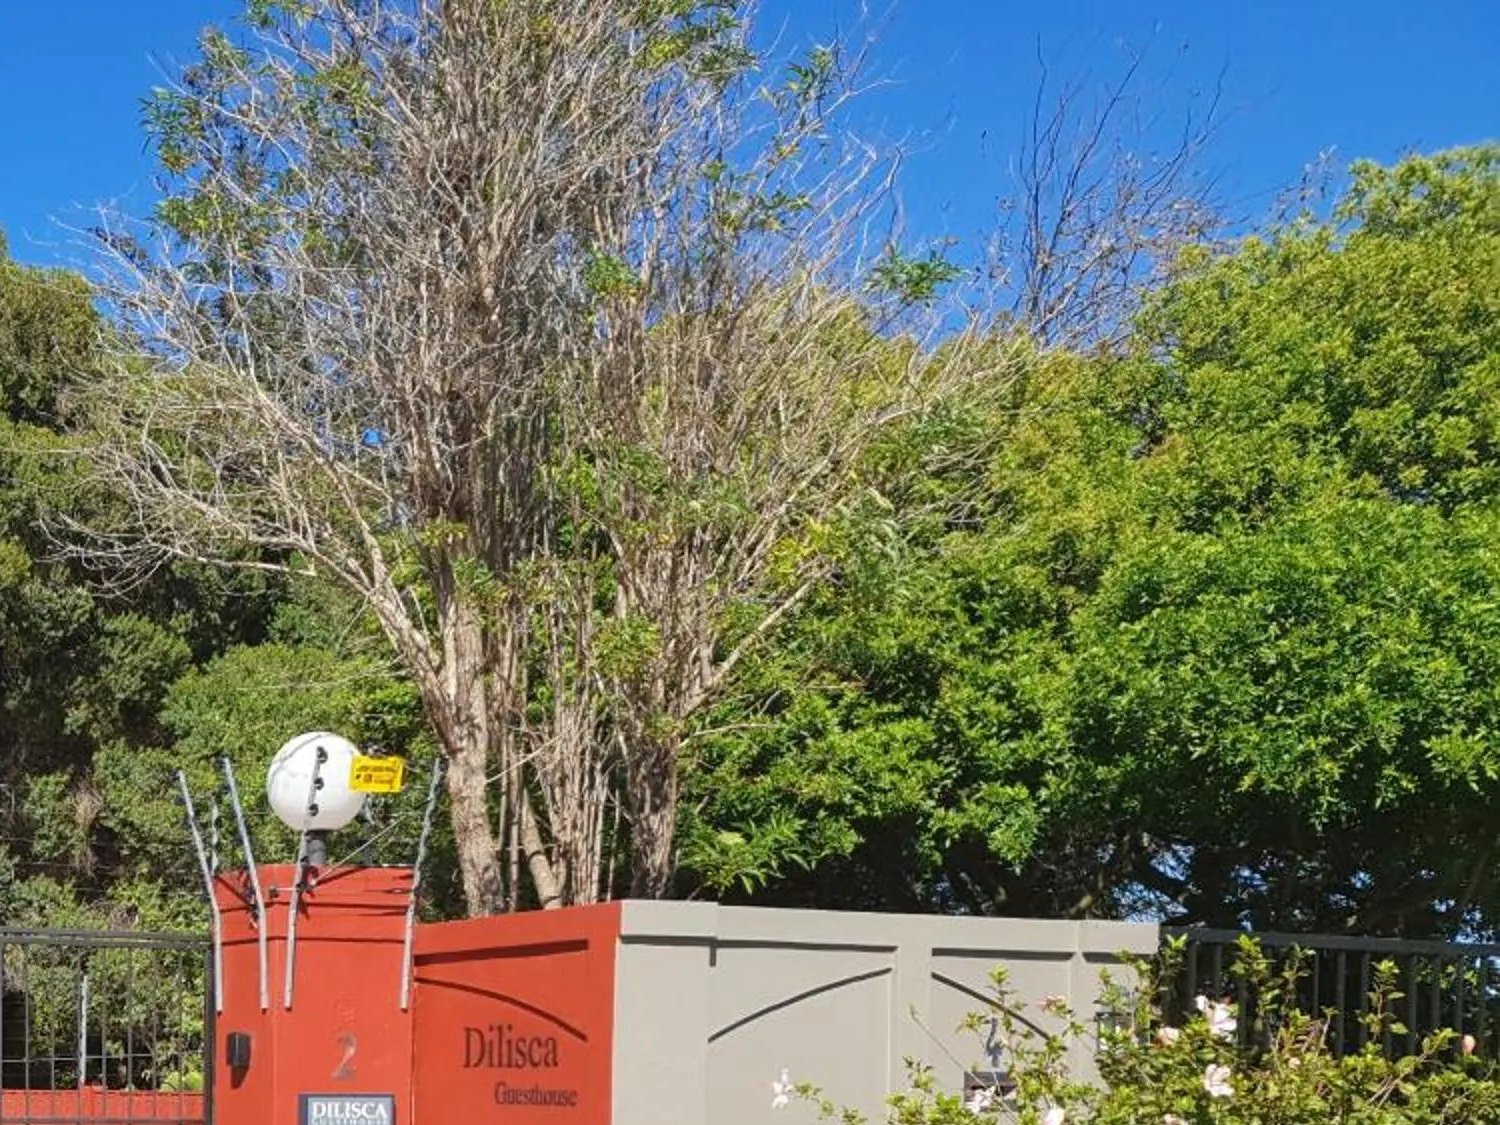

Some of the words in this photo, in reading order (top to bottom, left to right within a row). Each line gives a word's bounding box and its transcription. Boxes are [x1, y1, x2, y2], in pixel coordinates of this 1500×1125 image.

[331, 1030, 357, 1081] 2
[463, 1024, 560, 1070] Dilisca
[312, 1101, 388, 1119] DILISCA
[494, 1081, 579, 1107] Guesthouse
